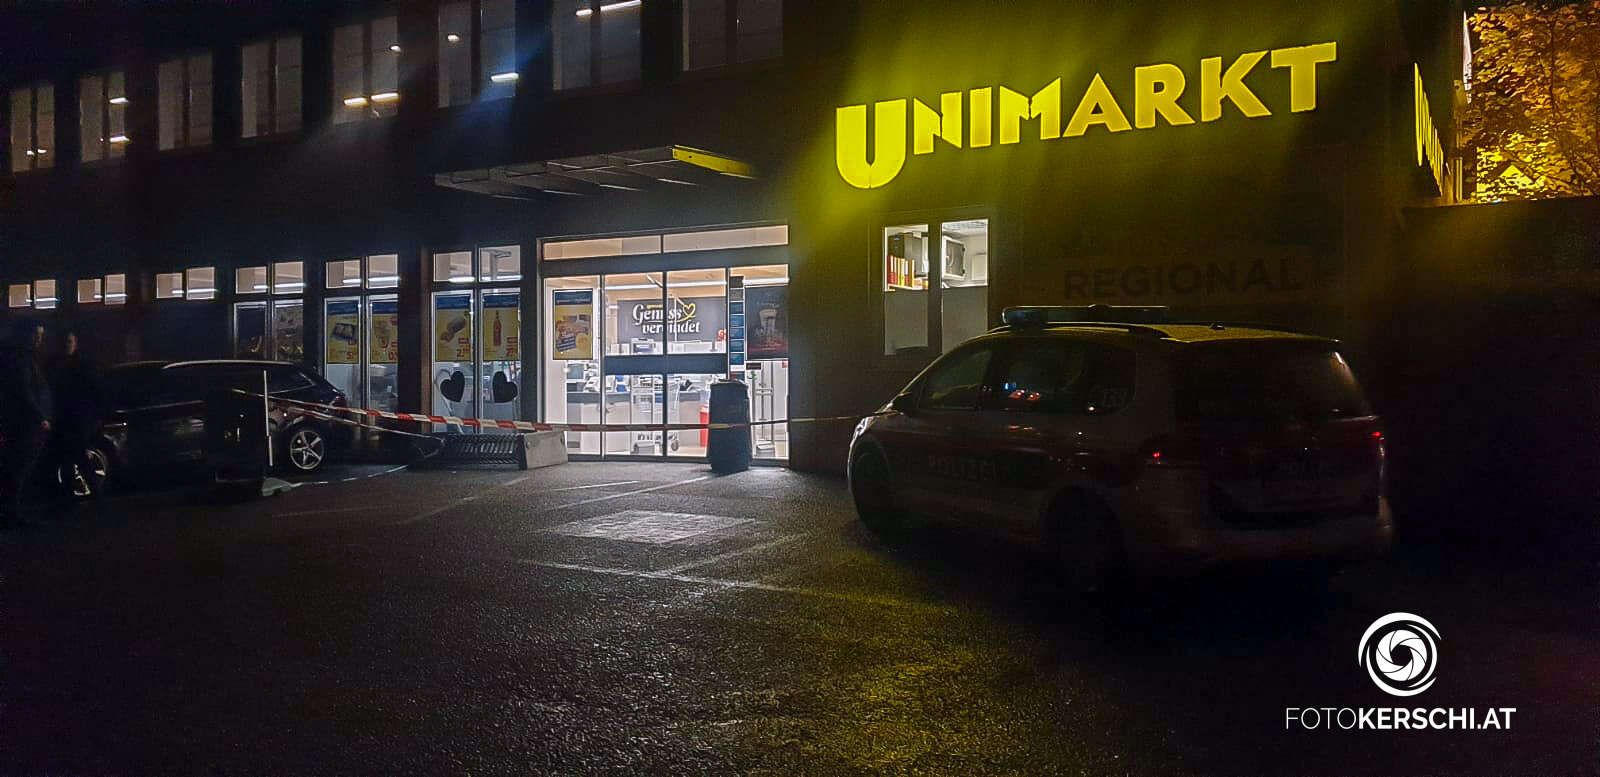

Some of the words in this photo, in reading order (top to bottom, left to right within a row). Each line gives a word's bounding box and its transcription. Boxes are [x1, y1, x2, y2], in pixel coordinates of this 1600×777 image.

[836, 41, 1337, 188] UNIMARKT
[1063, 258, 1303, 299] REGIONAL
[642, 320, 700, 334] verindet
